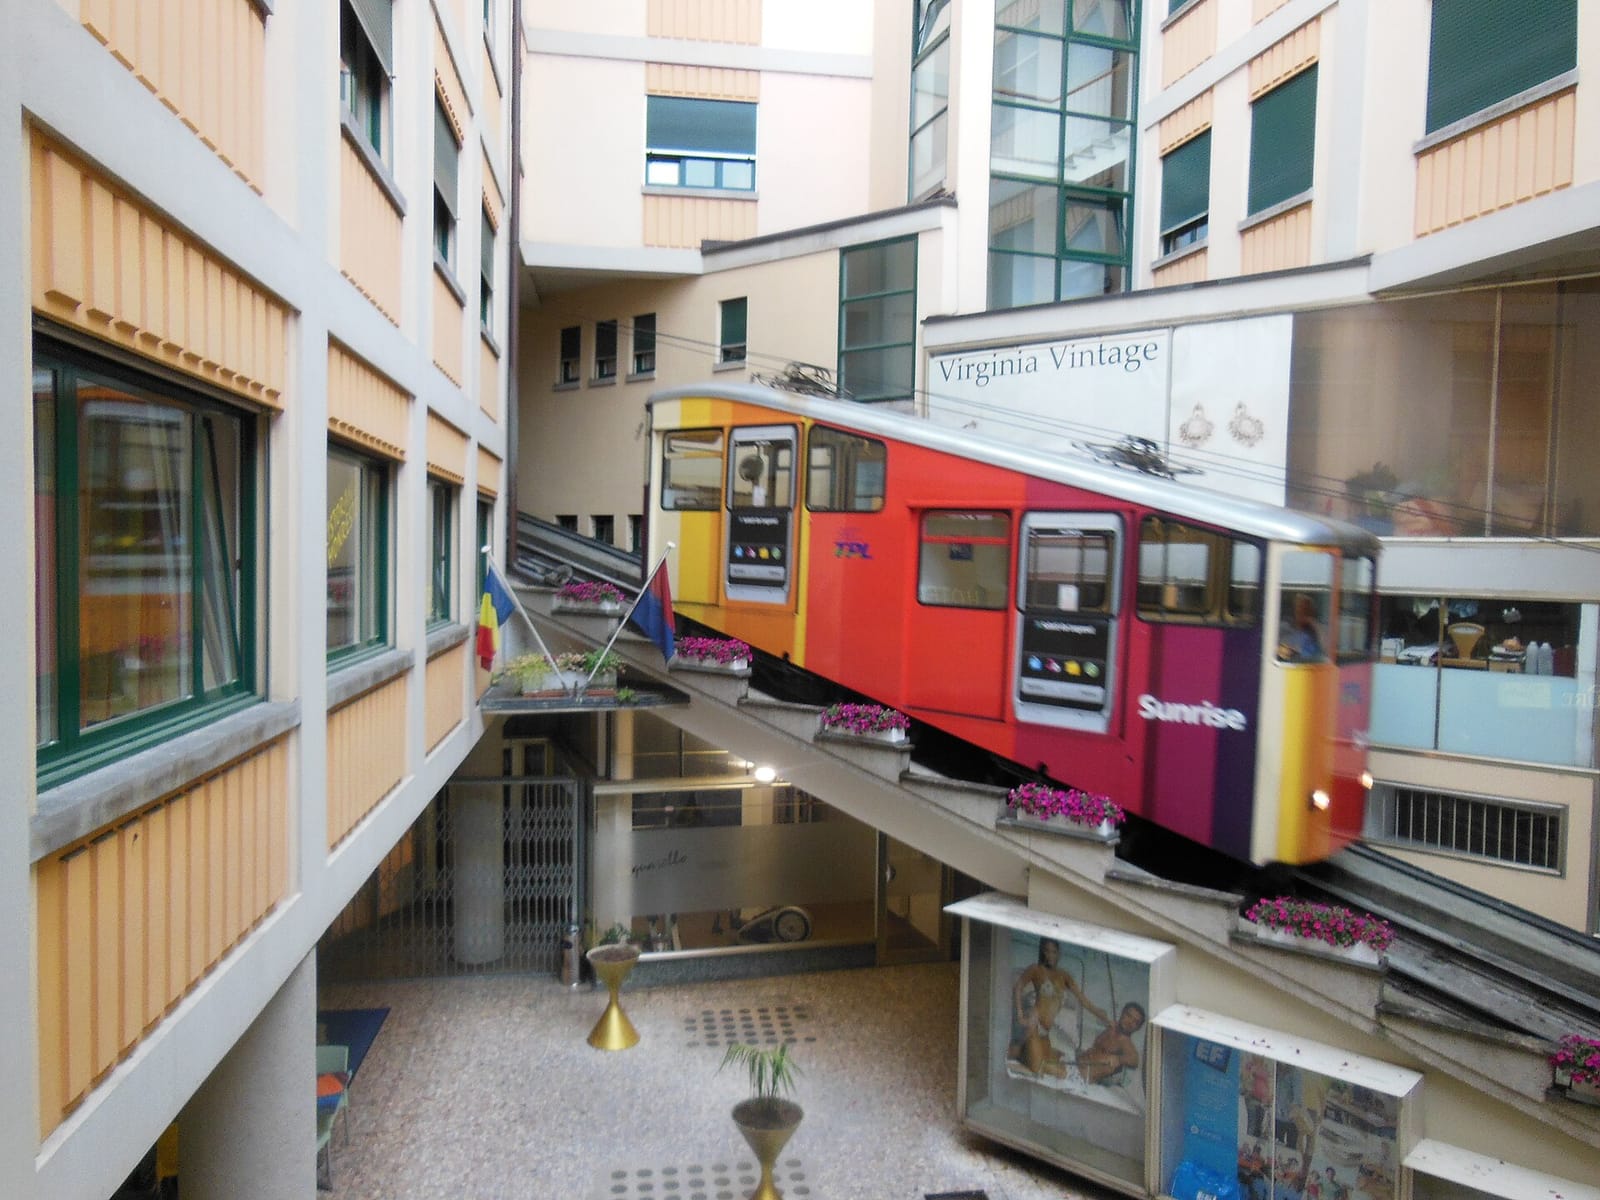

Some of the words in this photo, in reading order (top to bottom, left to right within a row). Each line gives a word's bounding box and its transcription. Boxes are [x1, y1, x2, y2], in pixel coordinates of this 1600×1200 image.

[939, 350, 1039, 387] Virginia
[1050, 341, 1158, 372] Vintage
[1138, 694, 1247, 731] Sunrise
